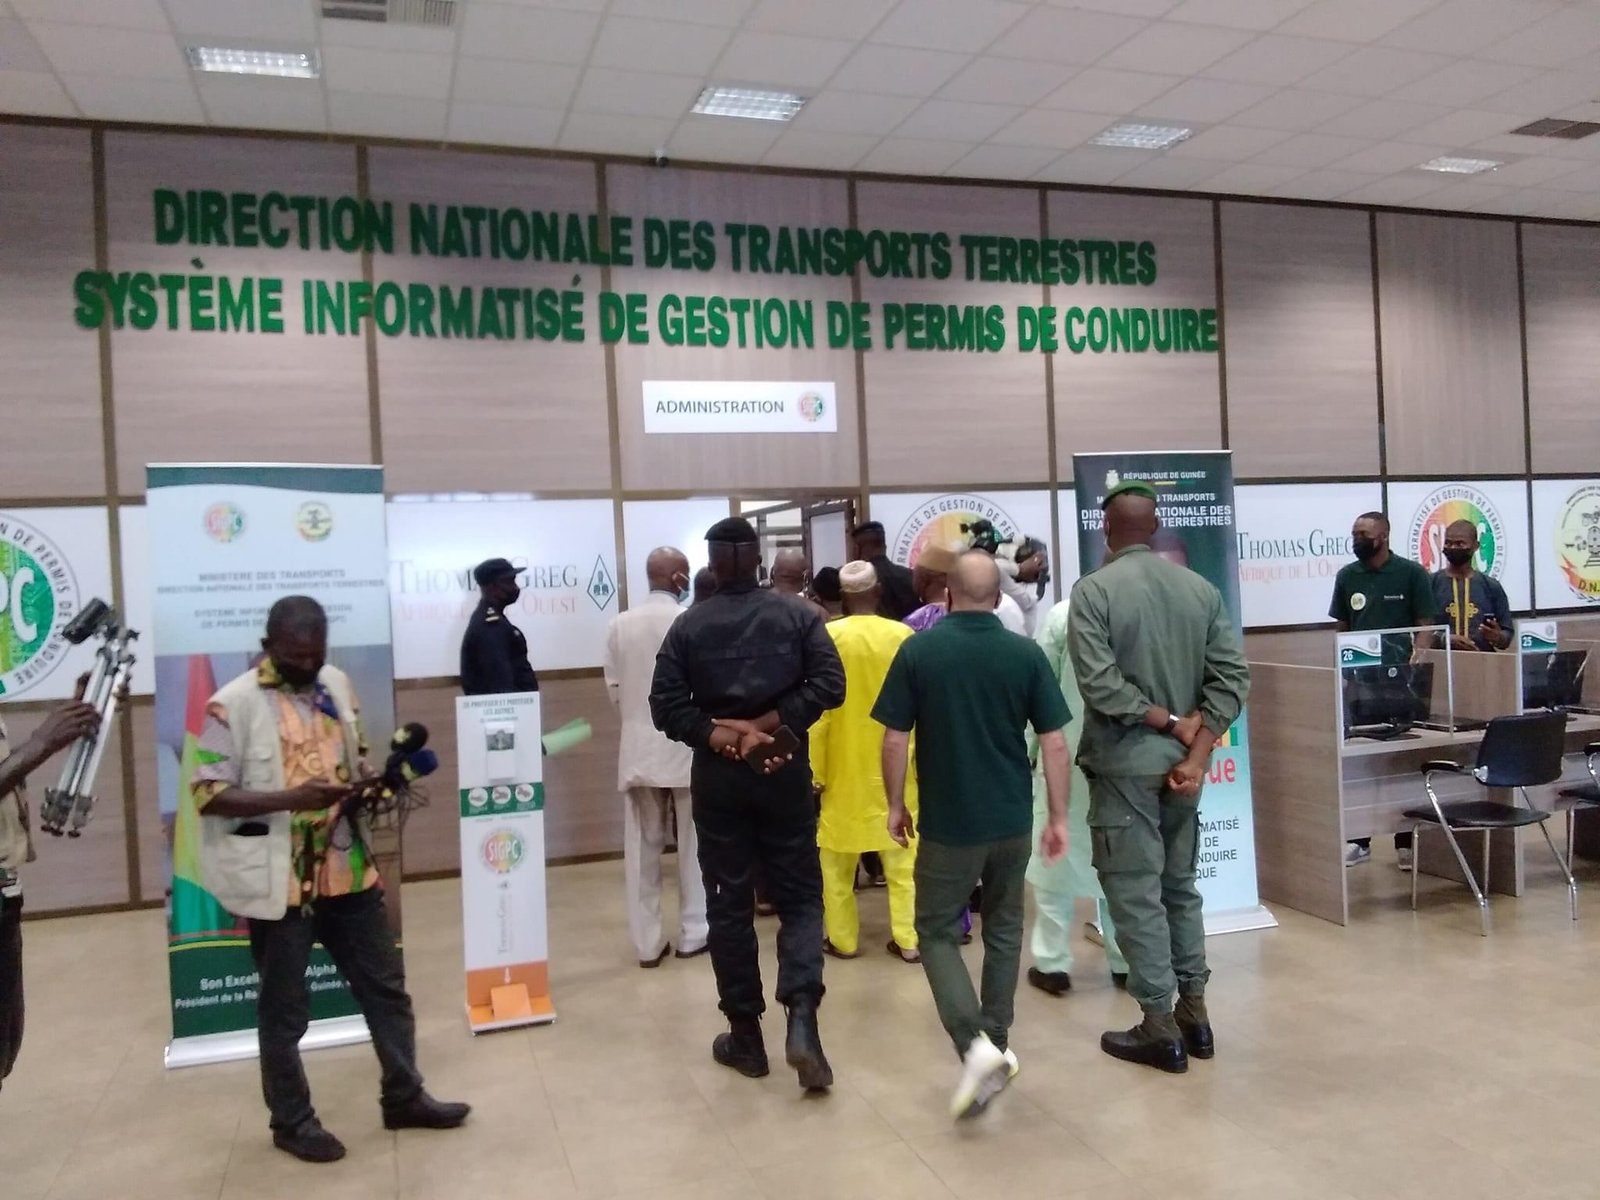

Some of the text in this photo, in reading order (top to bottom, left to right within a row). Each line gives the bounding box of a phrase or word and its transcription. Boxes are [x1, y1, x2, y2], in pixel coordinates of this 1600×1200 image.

[155, 188, 1157, 286] DIRECTION NATIONALE DES TRANSPORTS TERRESTRES
[74, 258, 1220, 353] SYSTÈME INFORMATISÉ DE GESTION DE PERMIS DE CONDUIRE
[655, 400, 784, 413] ADMINISTRATION
[1169, 471, 1180, 479] DE
[1180, 470, 1206, 479] GUINÉE
[1162, 493, 1216, 503] TRANSPORTS
[1442, 488, 1475, 500] GESTION
[1154, 505, 1231, 517] ATIONALE DES
[923, 506, 937, 519] DE
[939, 499, 984, 513] GESTION
[986, 508, 1000, 523] DE
[1000, 520, 1016, 540] PER
[1161, 515, 1231, 528] TERRESTRES
[1236, 530, 1305, 560] THOMAS
[14, 529, 35, 546] DE
[34, 543, 71, 594] PERMIS
[58, 600, 72, 618] DE
[1522, 636, 1533, 646] 25
[1343, 650, 1354, 661] 26
[1200, 815, 1240, 832] MATISÉ
[1204, 836, 1219, 848] DE
[1198, 849, 1237, 863] NDUIRE
[200, 964, 337, 991] Son Excell Alpha
